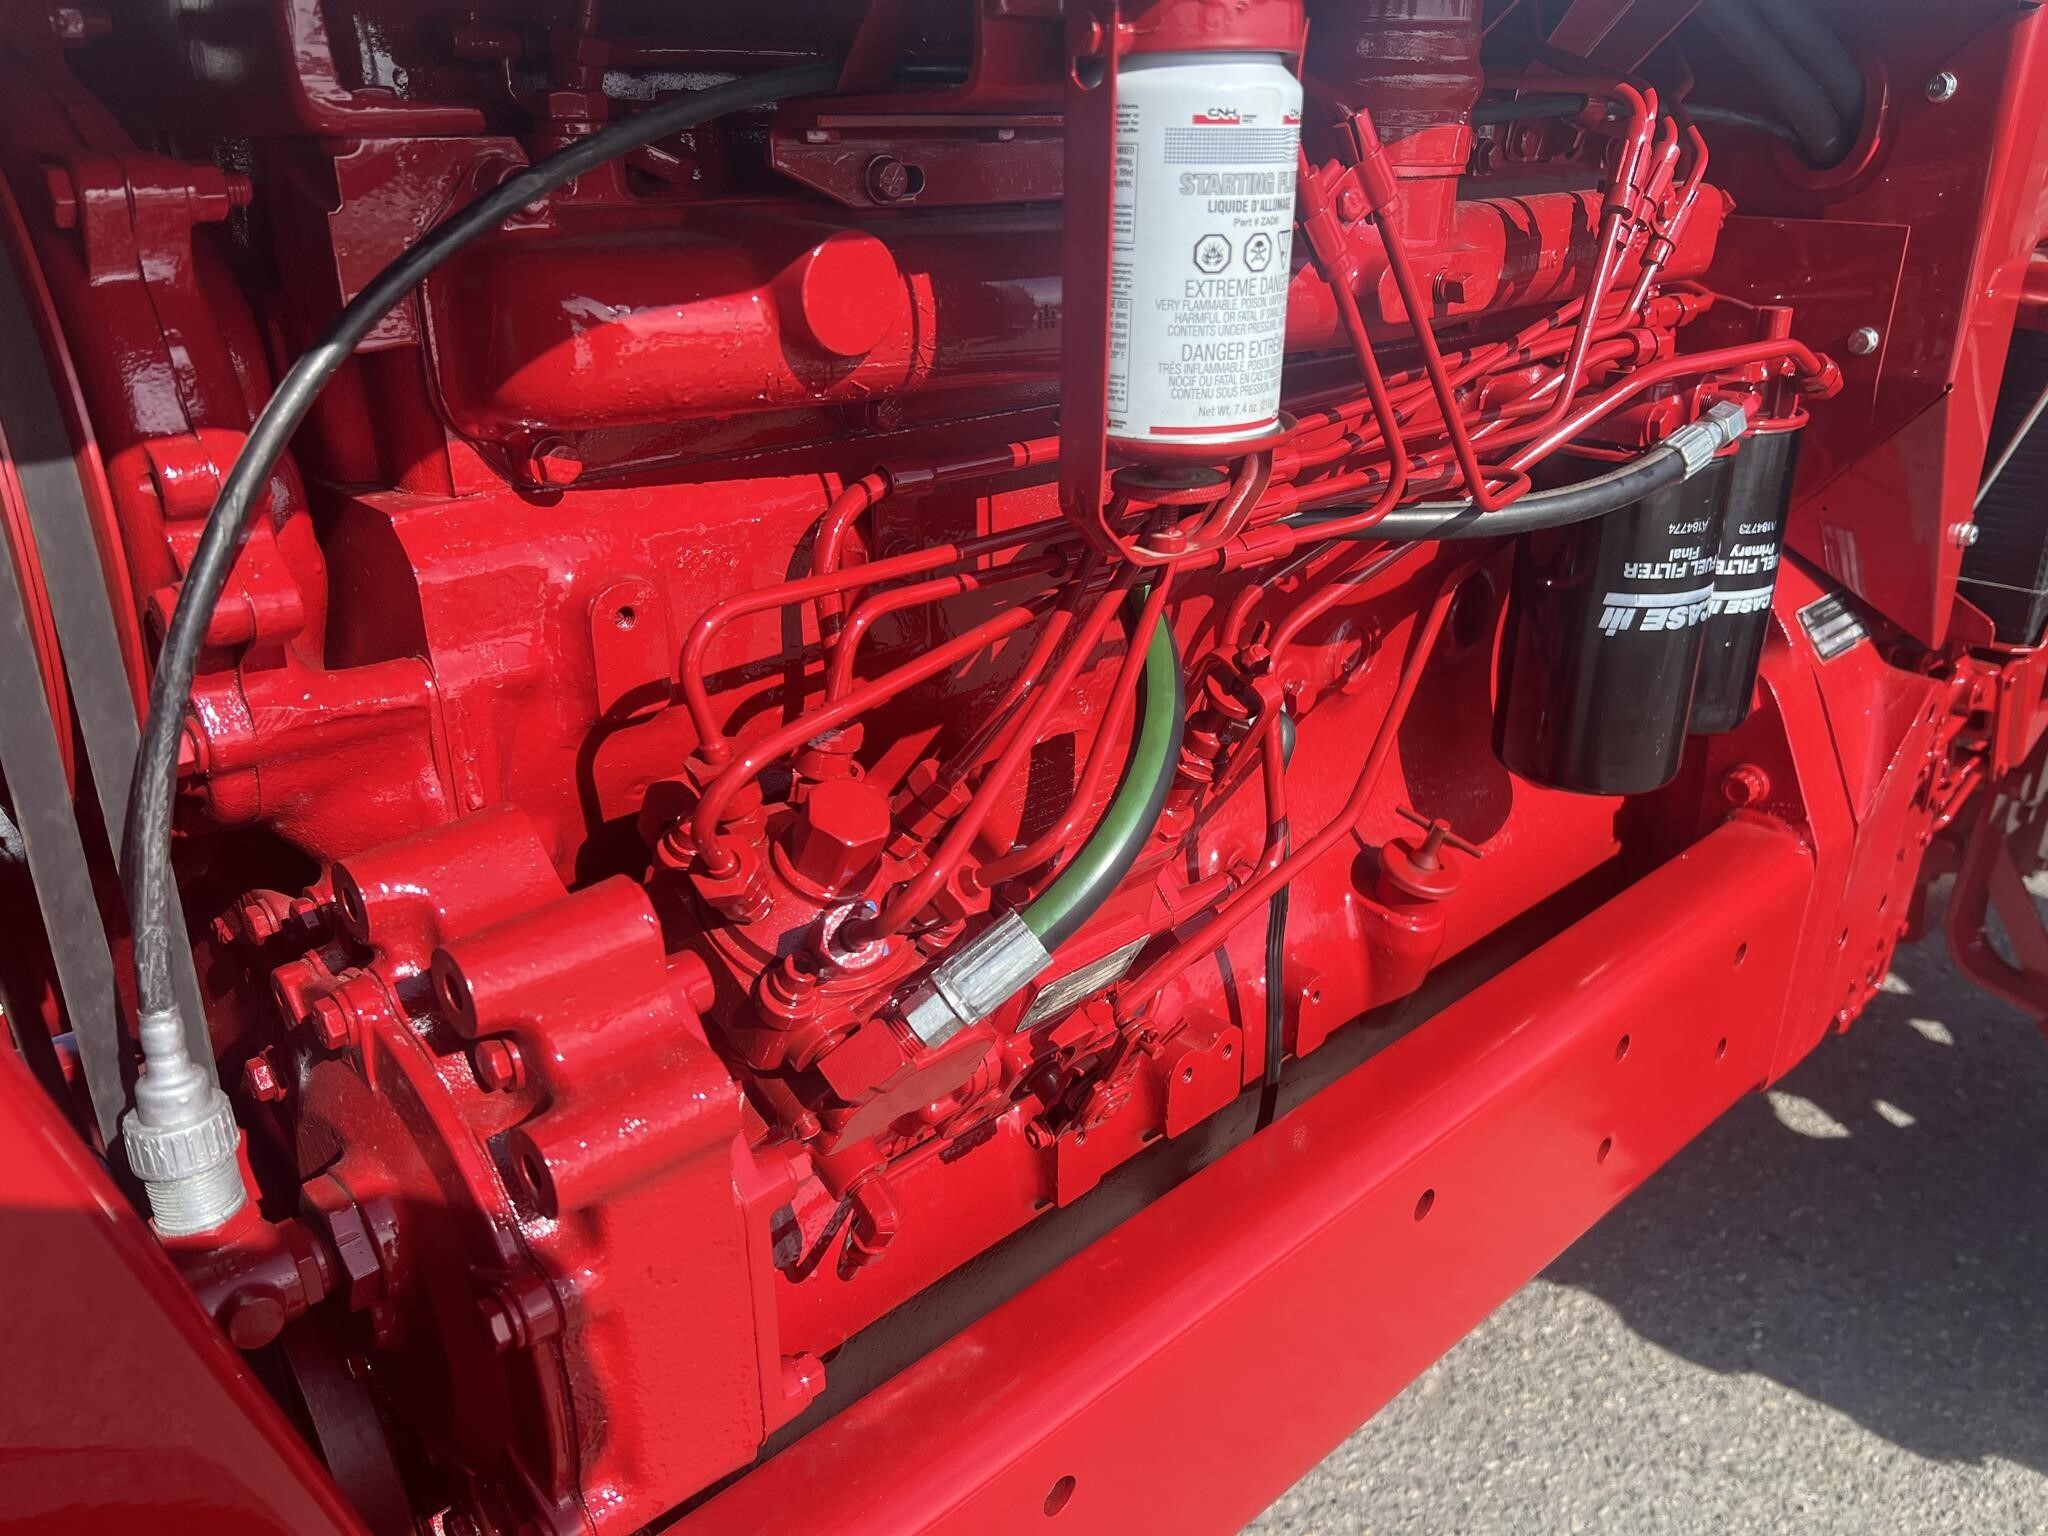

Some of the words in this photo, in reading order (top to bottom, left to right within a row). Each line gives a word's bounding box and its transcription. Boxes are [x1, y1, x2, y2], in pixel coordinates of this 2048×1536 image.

[1207, 108, 1237, 118] CNH
[1179, 173, 1275, 196] STARTING
[1207, 199, 1248, 215] LIQUIDE
[1233, 217, 1252, 228] Part
[1185, 276, 1256, 299] EXTREME
[1155, 300, 1180, 312] VERY
[1174, 312, 1220, 325] HARMFUL
[1223, 312, 1235, 323] OR
[1167, 325, 1216, 337] CONTENTS
[1218, 324, 1246, 336] UNDER
[1181, 343, 1245, 362] DANGER
[1168, 376, 1197, 388] NOCIF
[1199, 376, 1213, 387] OU
[1214, 374, 1238, 386] FATAL
[1170, 387, 1214, 400] CONTENU
[1215, 386, 1238, 399] SOUS
[1199, 406, 1215, 418] Net
[1668, 520, 1710, 535] A184774
[1670, 546, 1700, 562] Final
[1730, 542, 1775, 557] Primary
[1623, 560, 1685, 580] FILTER
[1690, 553, 1719, 577] FUEL
[1714, 559, 1756, 576] FILTE
[1724, 596, 1771, 615] CASE
[1640, 601, 1711, 631] CASE
